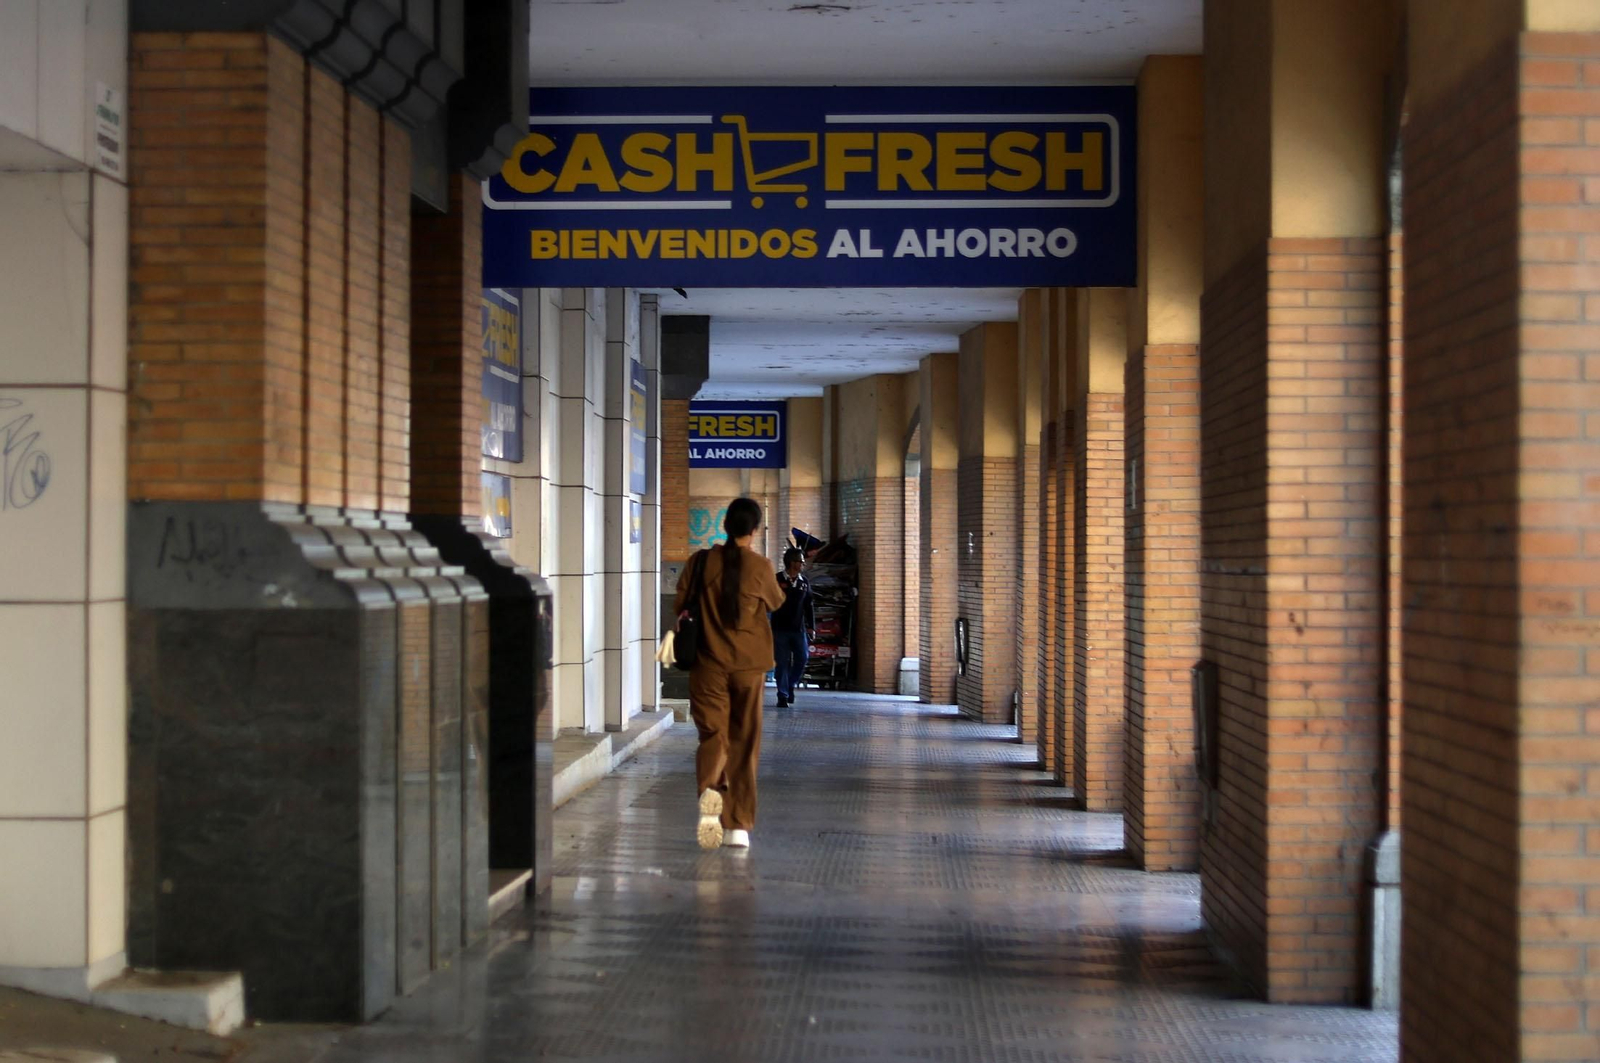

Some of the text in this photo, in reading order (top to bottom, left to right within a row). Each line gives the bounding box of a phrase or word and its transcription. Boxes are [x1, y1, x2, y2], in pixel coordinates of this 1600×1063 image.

[500, 131, 1103, 193] CASH FRESH
[531, 227, 1077, 259] BIENVENIDOS AL AHORRO
[704, 448, 766, 459] AHORRO
